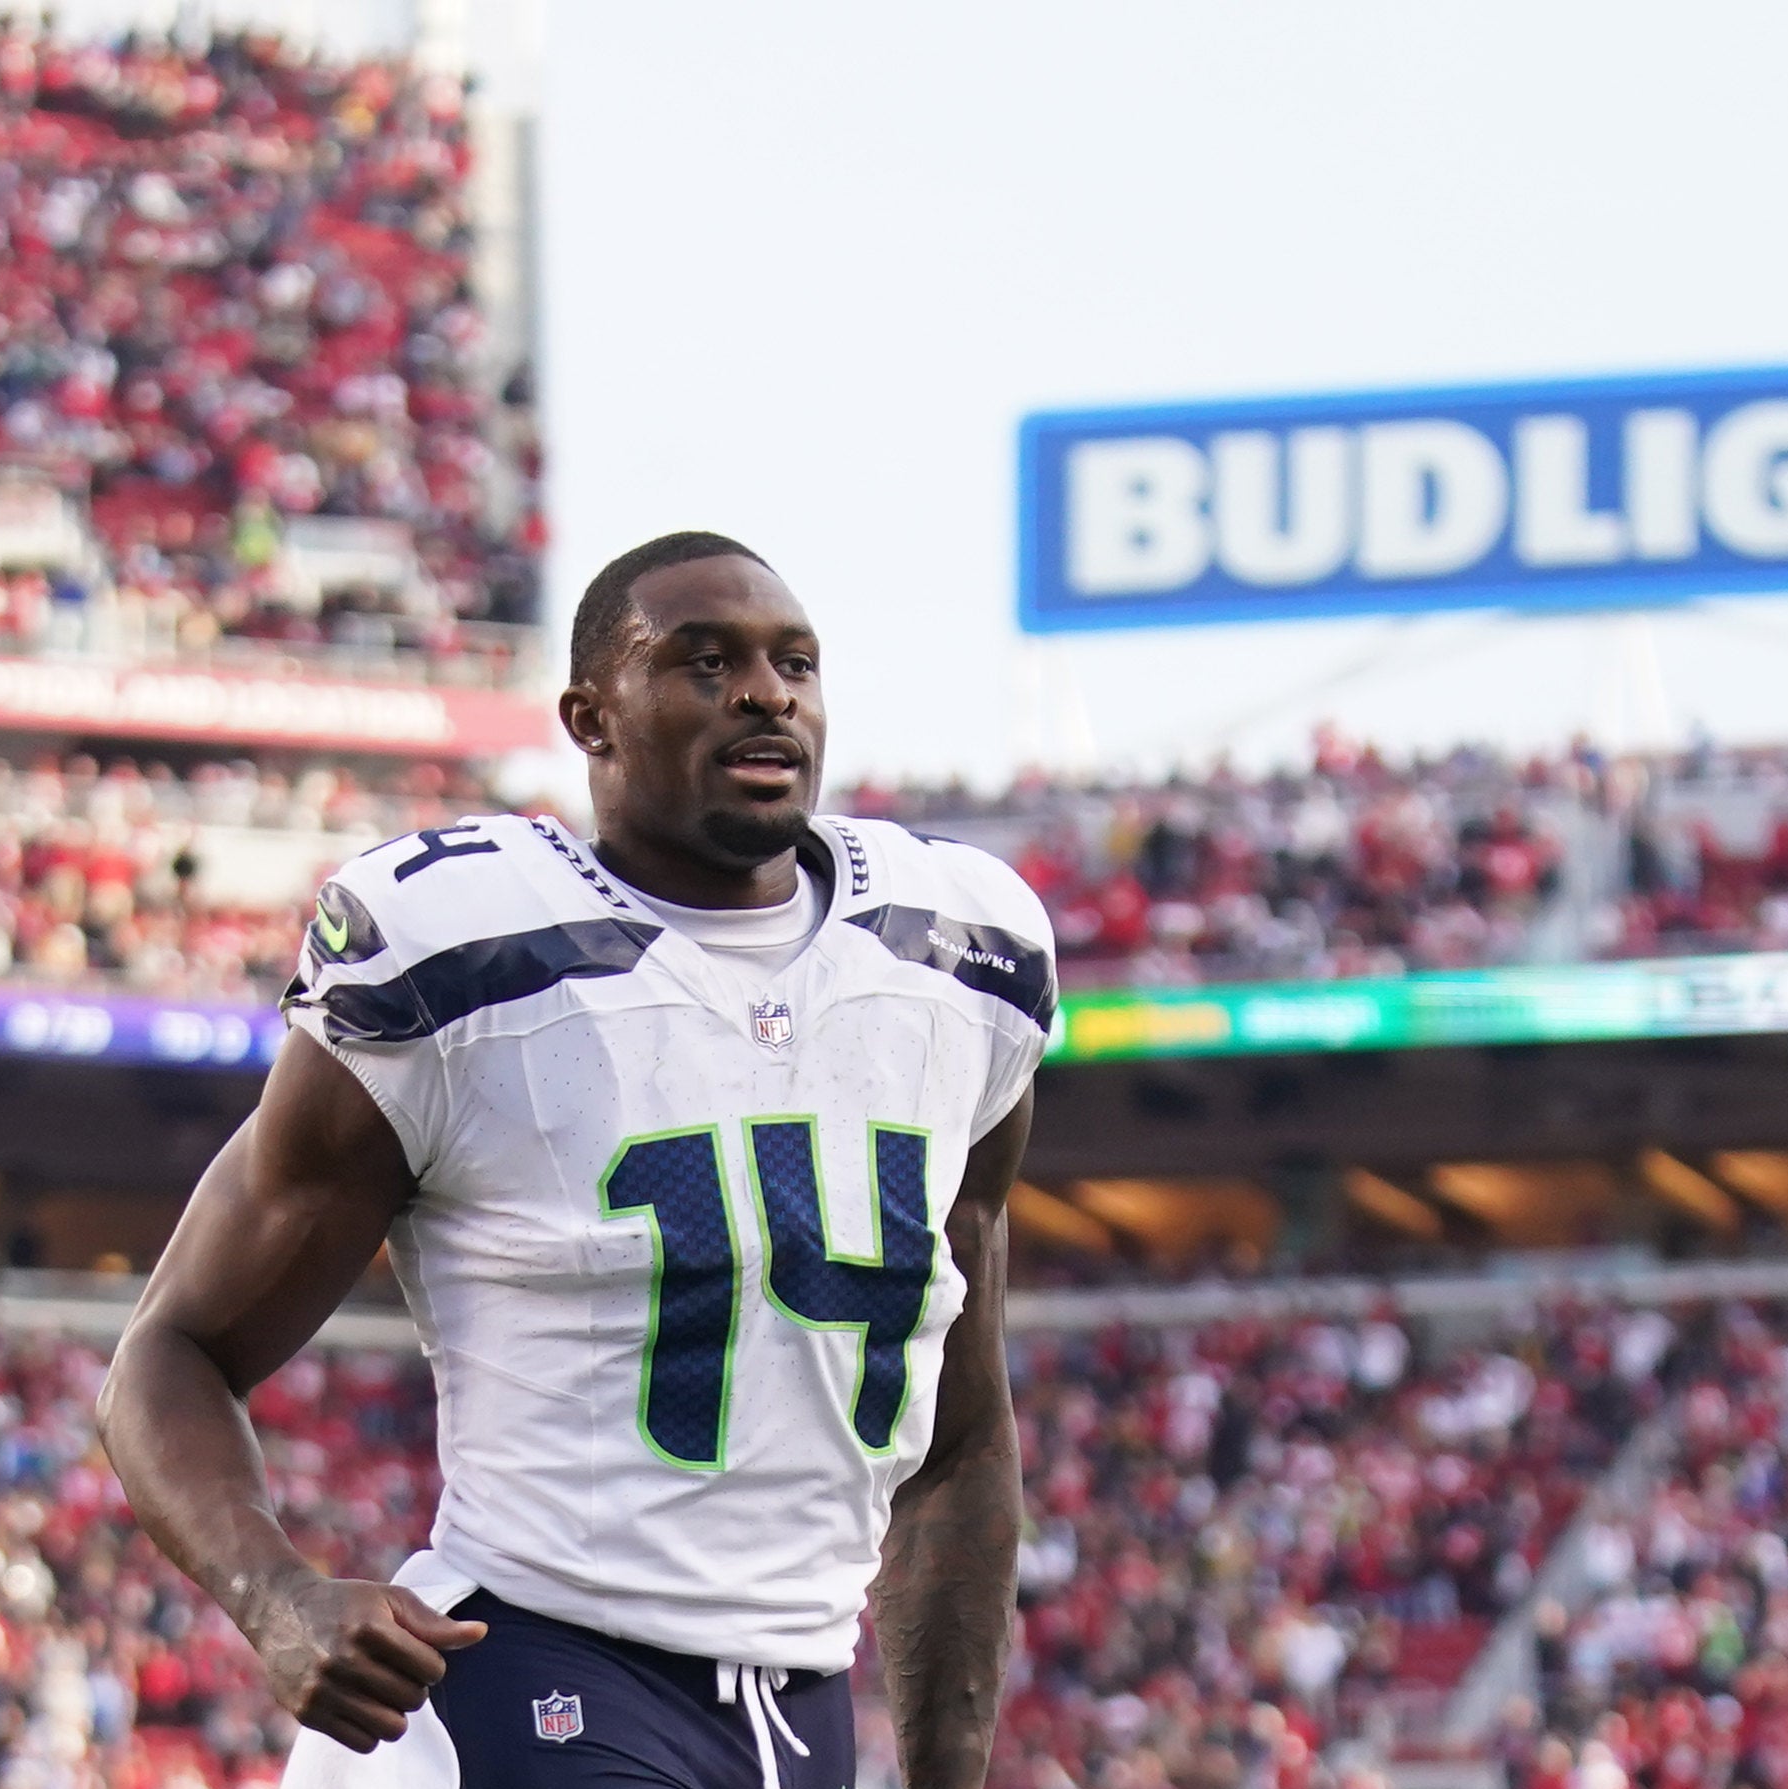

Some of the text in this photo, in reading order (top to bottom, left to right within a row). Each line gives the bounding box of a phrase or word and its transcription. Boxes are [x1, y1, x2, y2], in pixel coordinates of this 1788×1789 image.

[926, 928, 1018, 975] SEAHAWKS
[758, 1019, 789, 1041] NFL
[598, 1112, 940, 1472] 14
[543, 1713, 577, 1734] NFL
